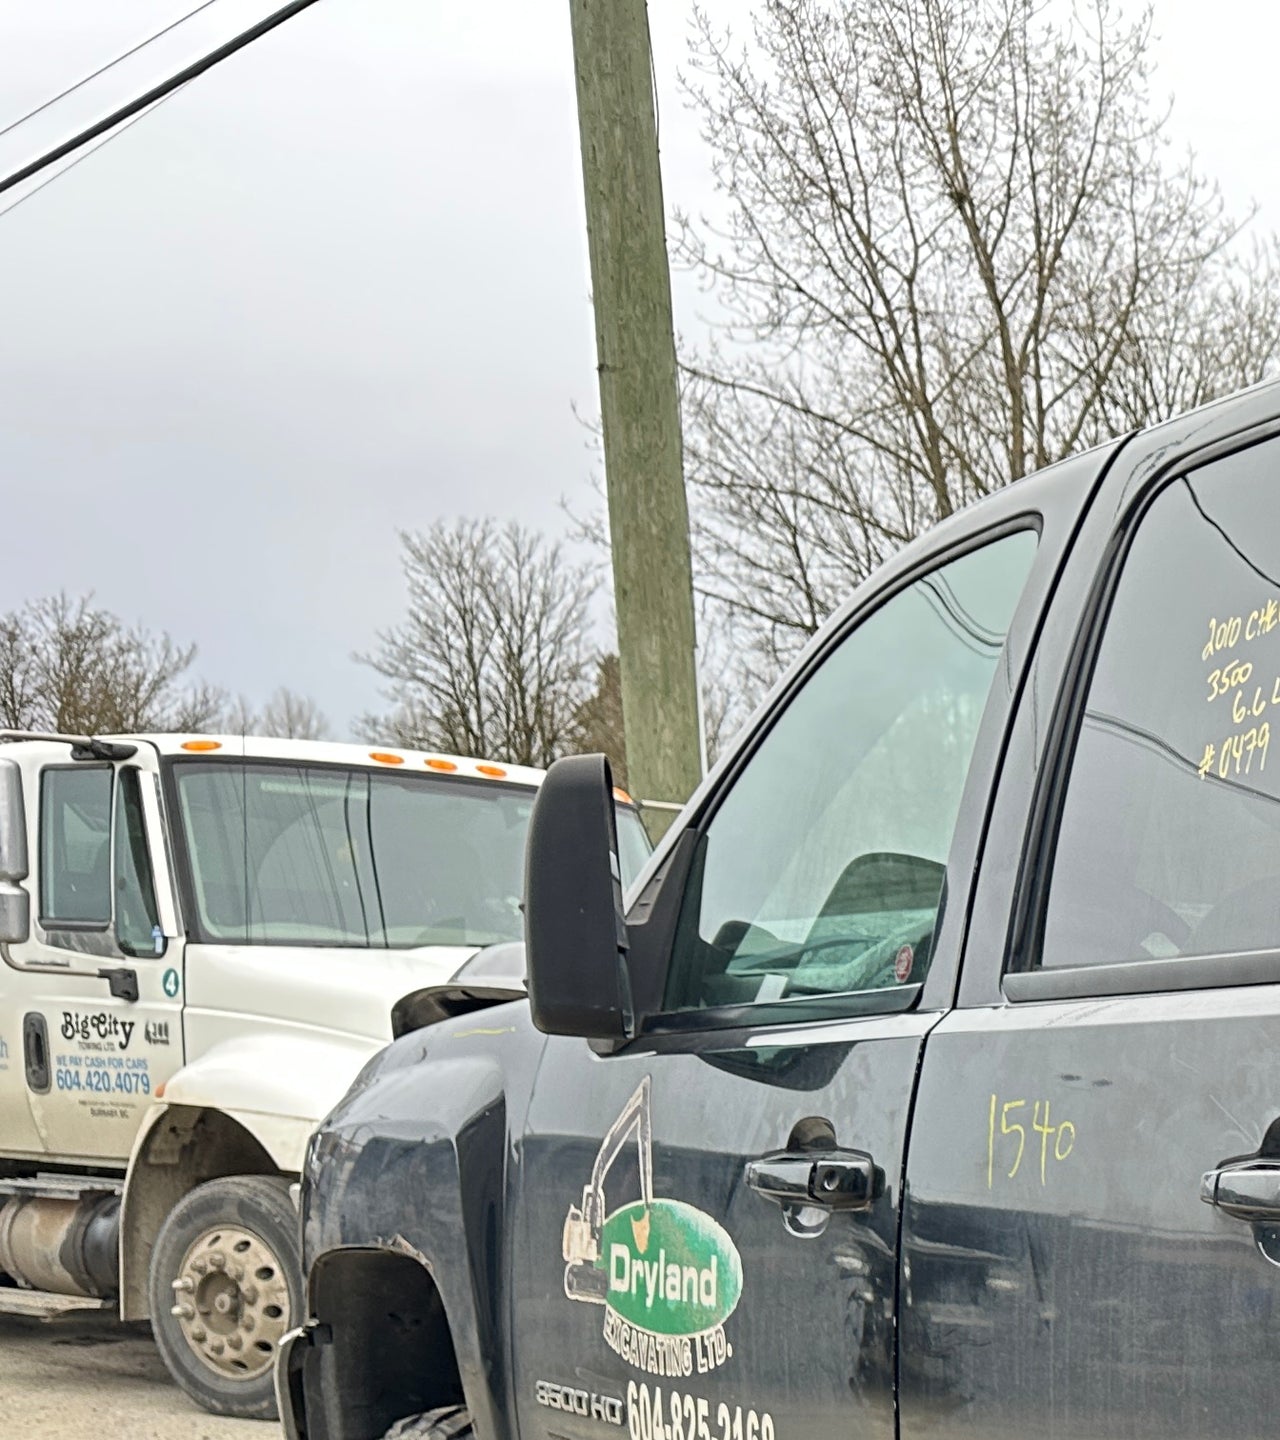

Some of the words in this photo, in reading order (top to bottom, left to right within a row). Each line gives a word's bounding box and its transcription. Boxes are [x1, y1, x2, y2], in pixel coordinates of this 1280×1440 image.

[1202, 617, 1242, 661] 2010
[1207, 659, 1253, 702] 3500
[1232, 687, 1266, 724] 6.6
[165, 973, 176, 996] 4
[56, 1055, 67, 1067] WE
[69, 1056, 82, 1067] PAY
[84, 1056, 106, 1068] CASH
[108, 1057, 124, 1068] FOR
[126, 1059, 148, 1070] CARS
[56, 1069, 150, 1095] 604.420.4079
[986, 1093, 1076, 1189] 1540
[609, 1243, 718, 1308] Dryland
[603, 1309, 693, 1378] EXCAVATING
[695, 1325, 733, 1374] LTD.
